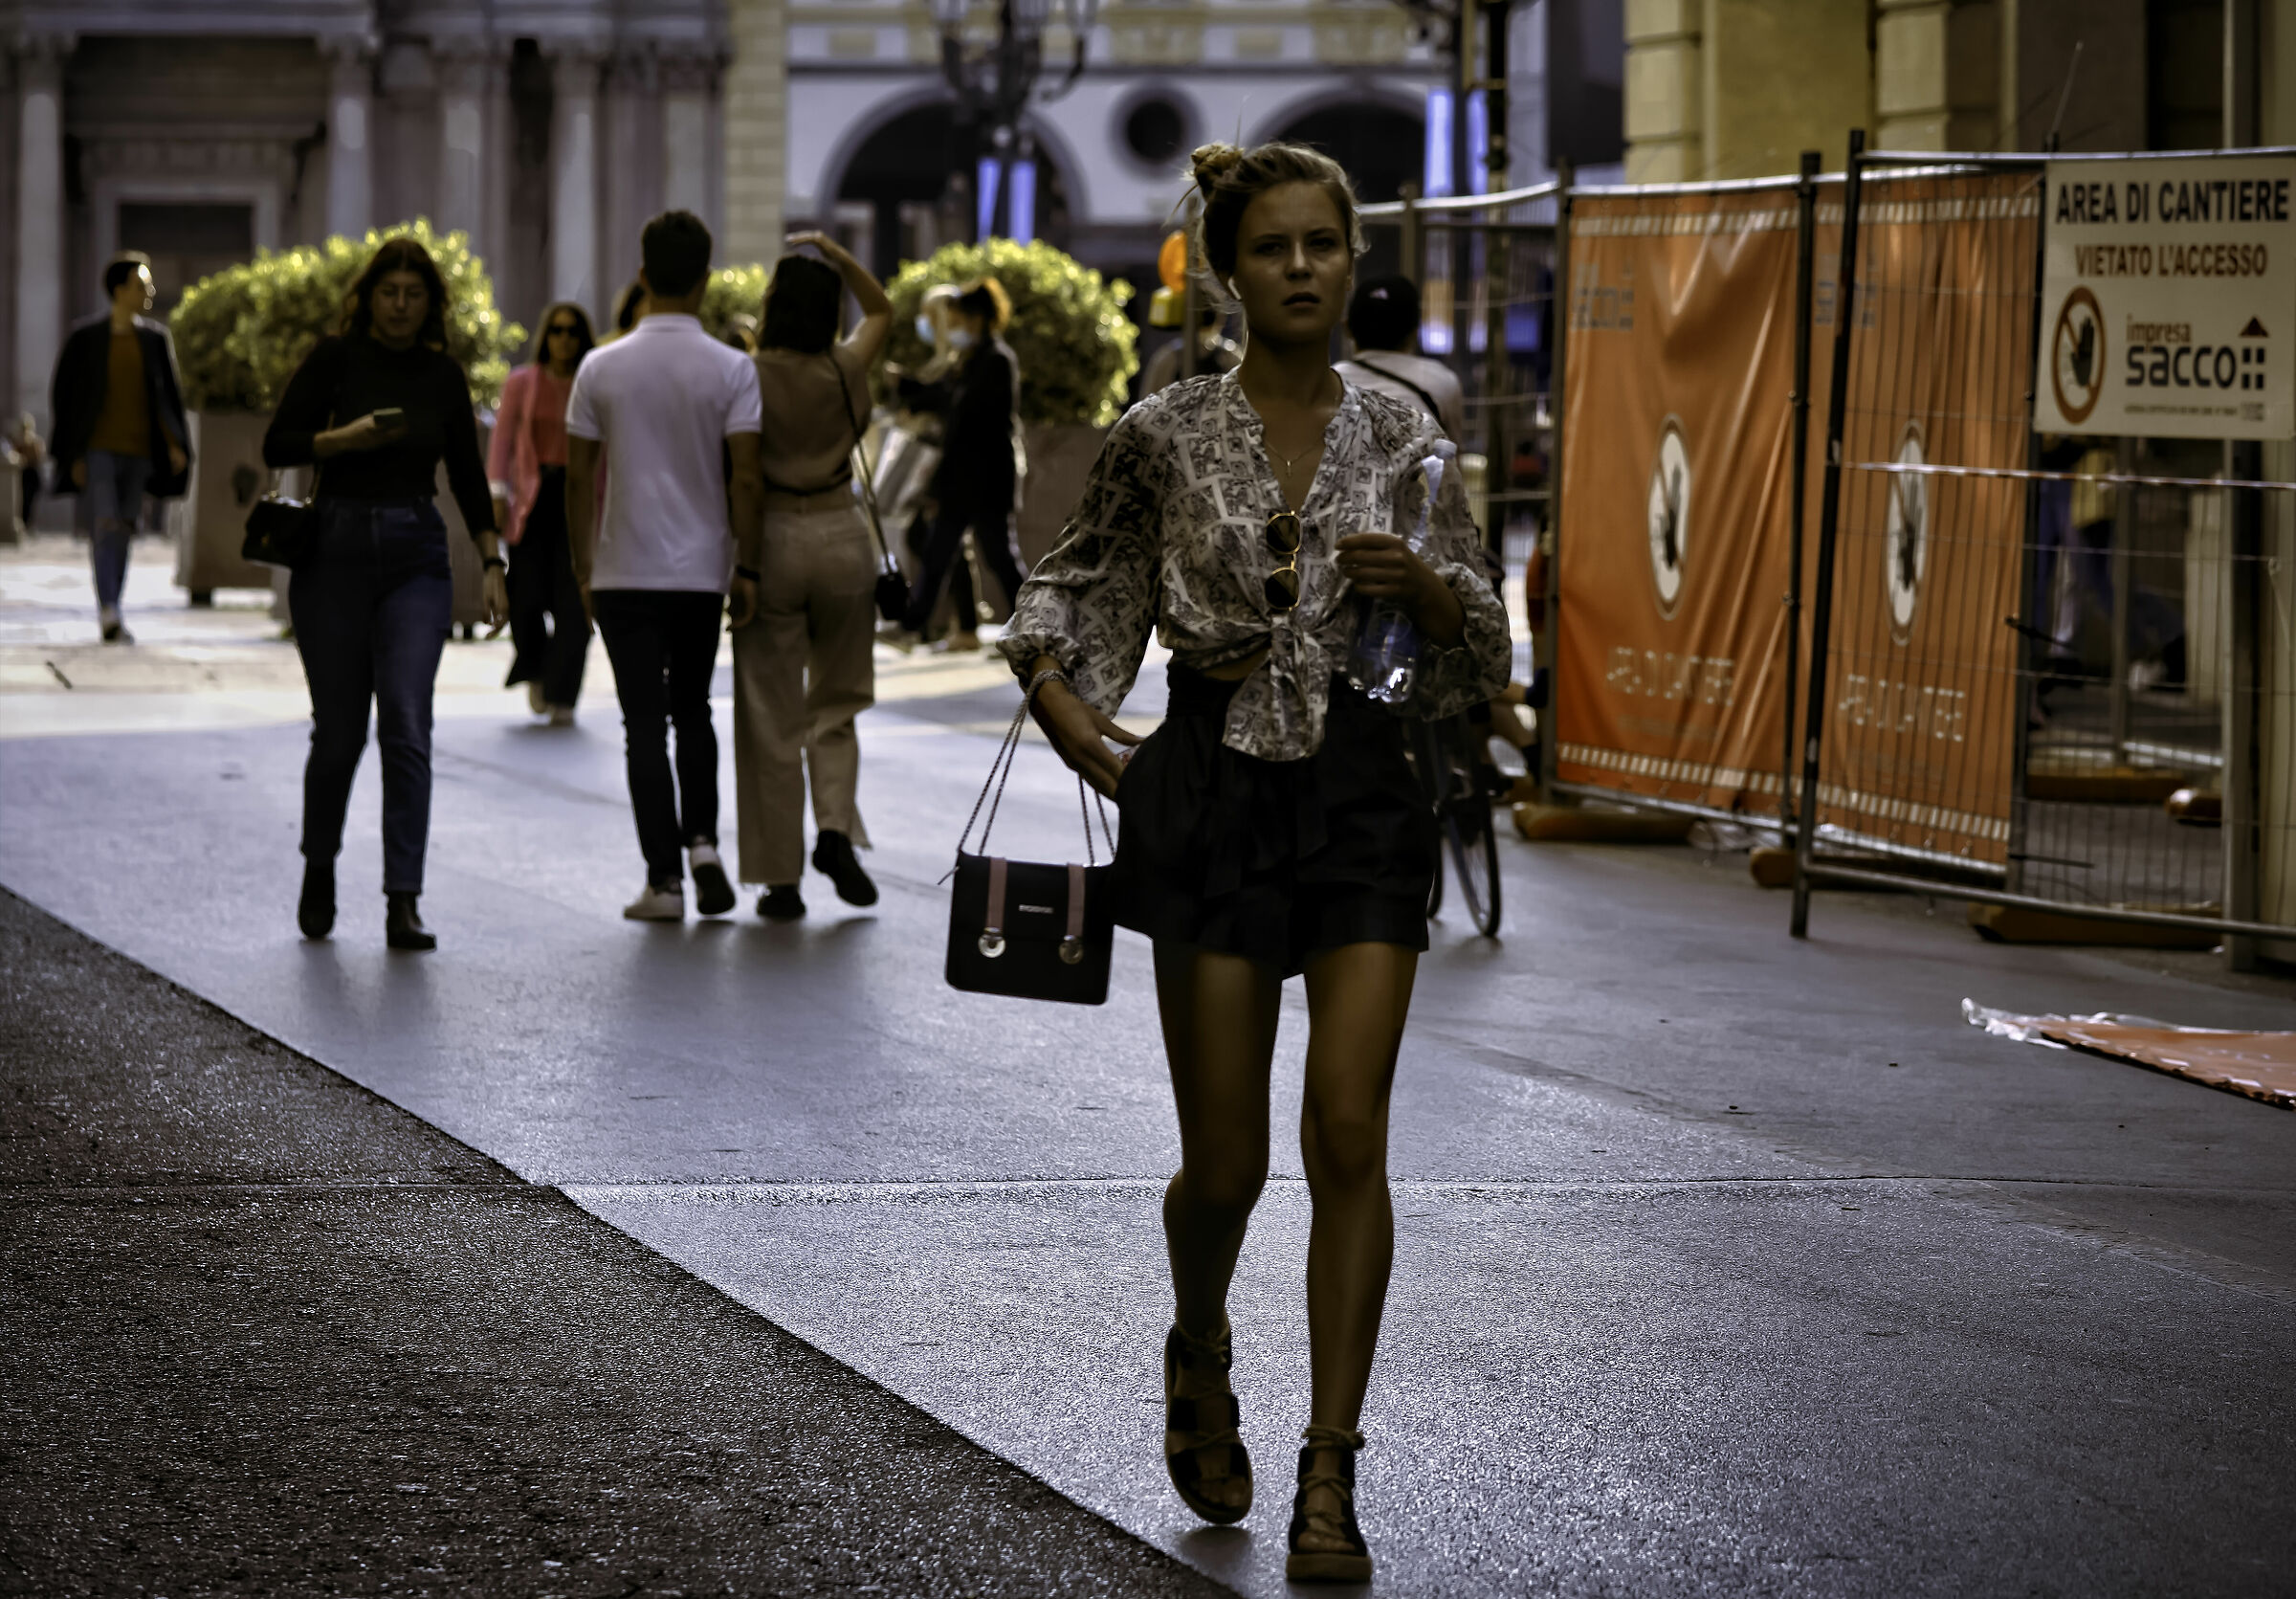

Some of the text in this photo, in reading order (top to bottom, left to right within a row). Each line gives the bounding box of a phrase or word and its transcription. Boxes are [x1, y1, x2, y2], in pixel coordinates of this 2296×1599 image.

[2057, 178, 2290, 223] AREA DI CANTIERE
[2074, 243, 2268, 277] VIETATO L'ACCESSO
[2126, 313, 2192, 353] impresa
[2125, 344, 2237, 389] sacco
